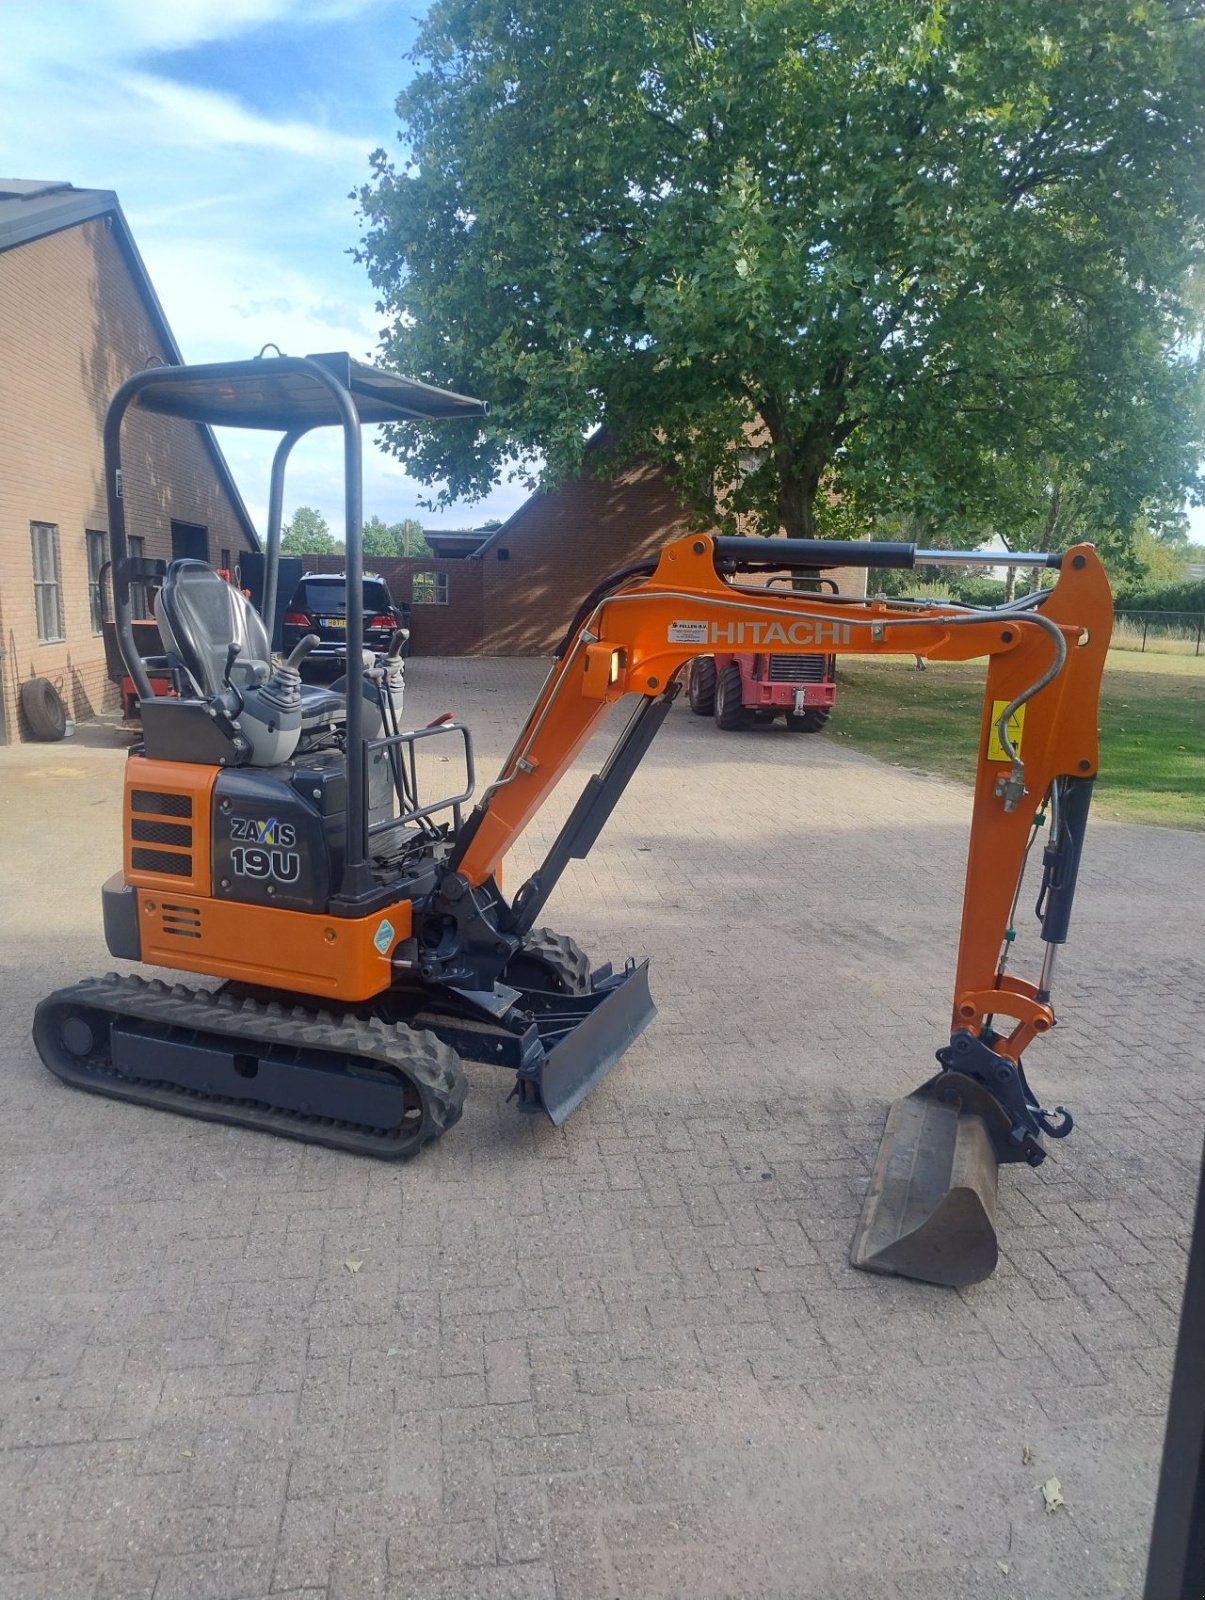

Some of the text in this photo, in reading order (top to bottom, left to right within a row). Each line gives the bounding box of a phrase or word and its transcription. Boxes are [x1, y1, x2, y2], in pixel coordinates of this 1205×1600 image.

[711, 621, 850, 645] HITACHI
[230, 817, 296, 848] ZAXIS
[230, 846, 300, 883] 19U
